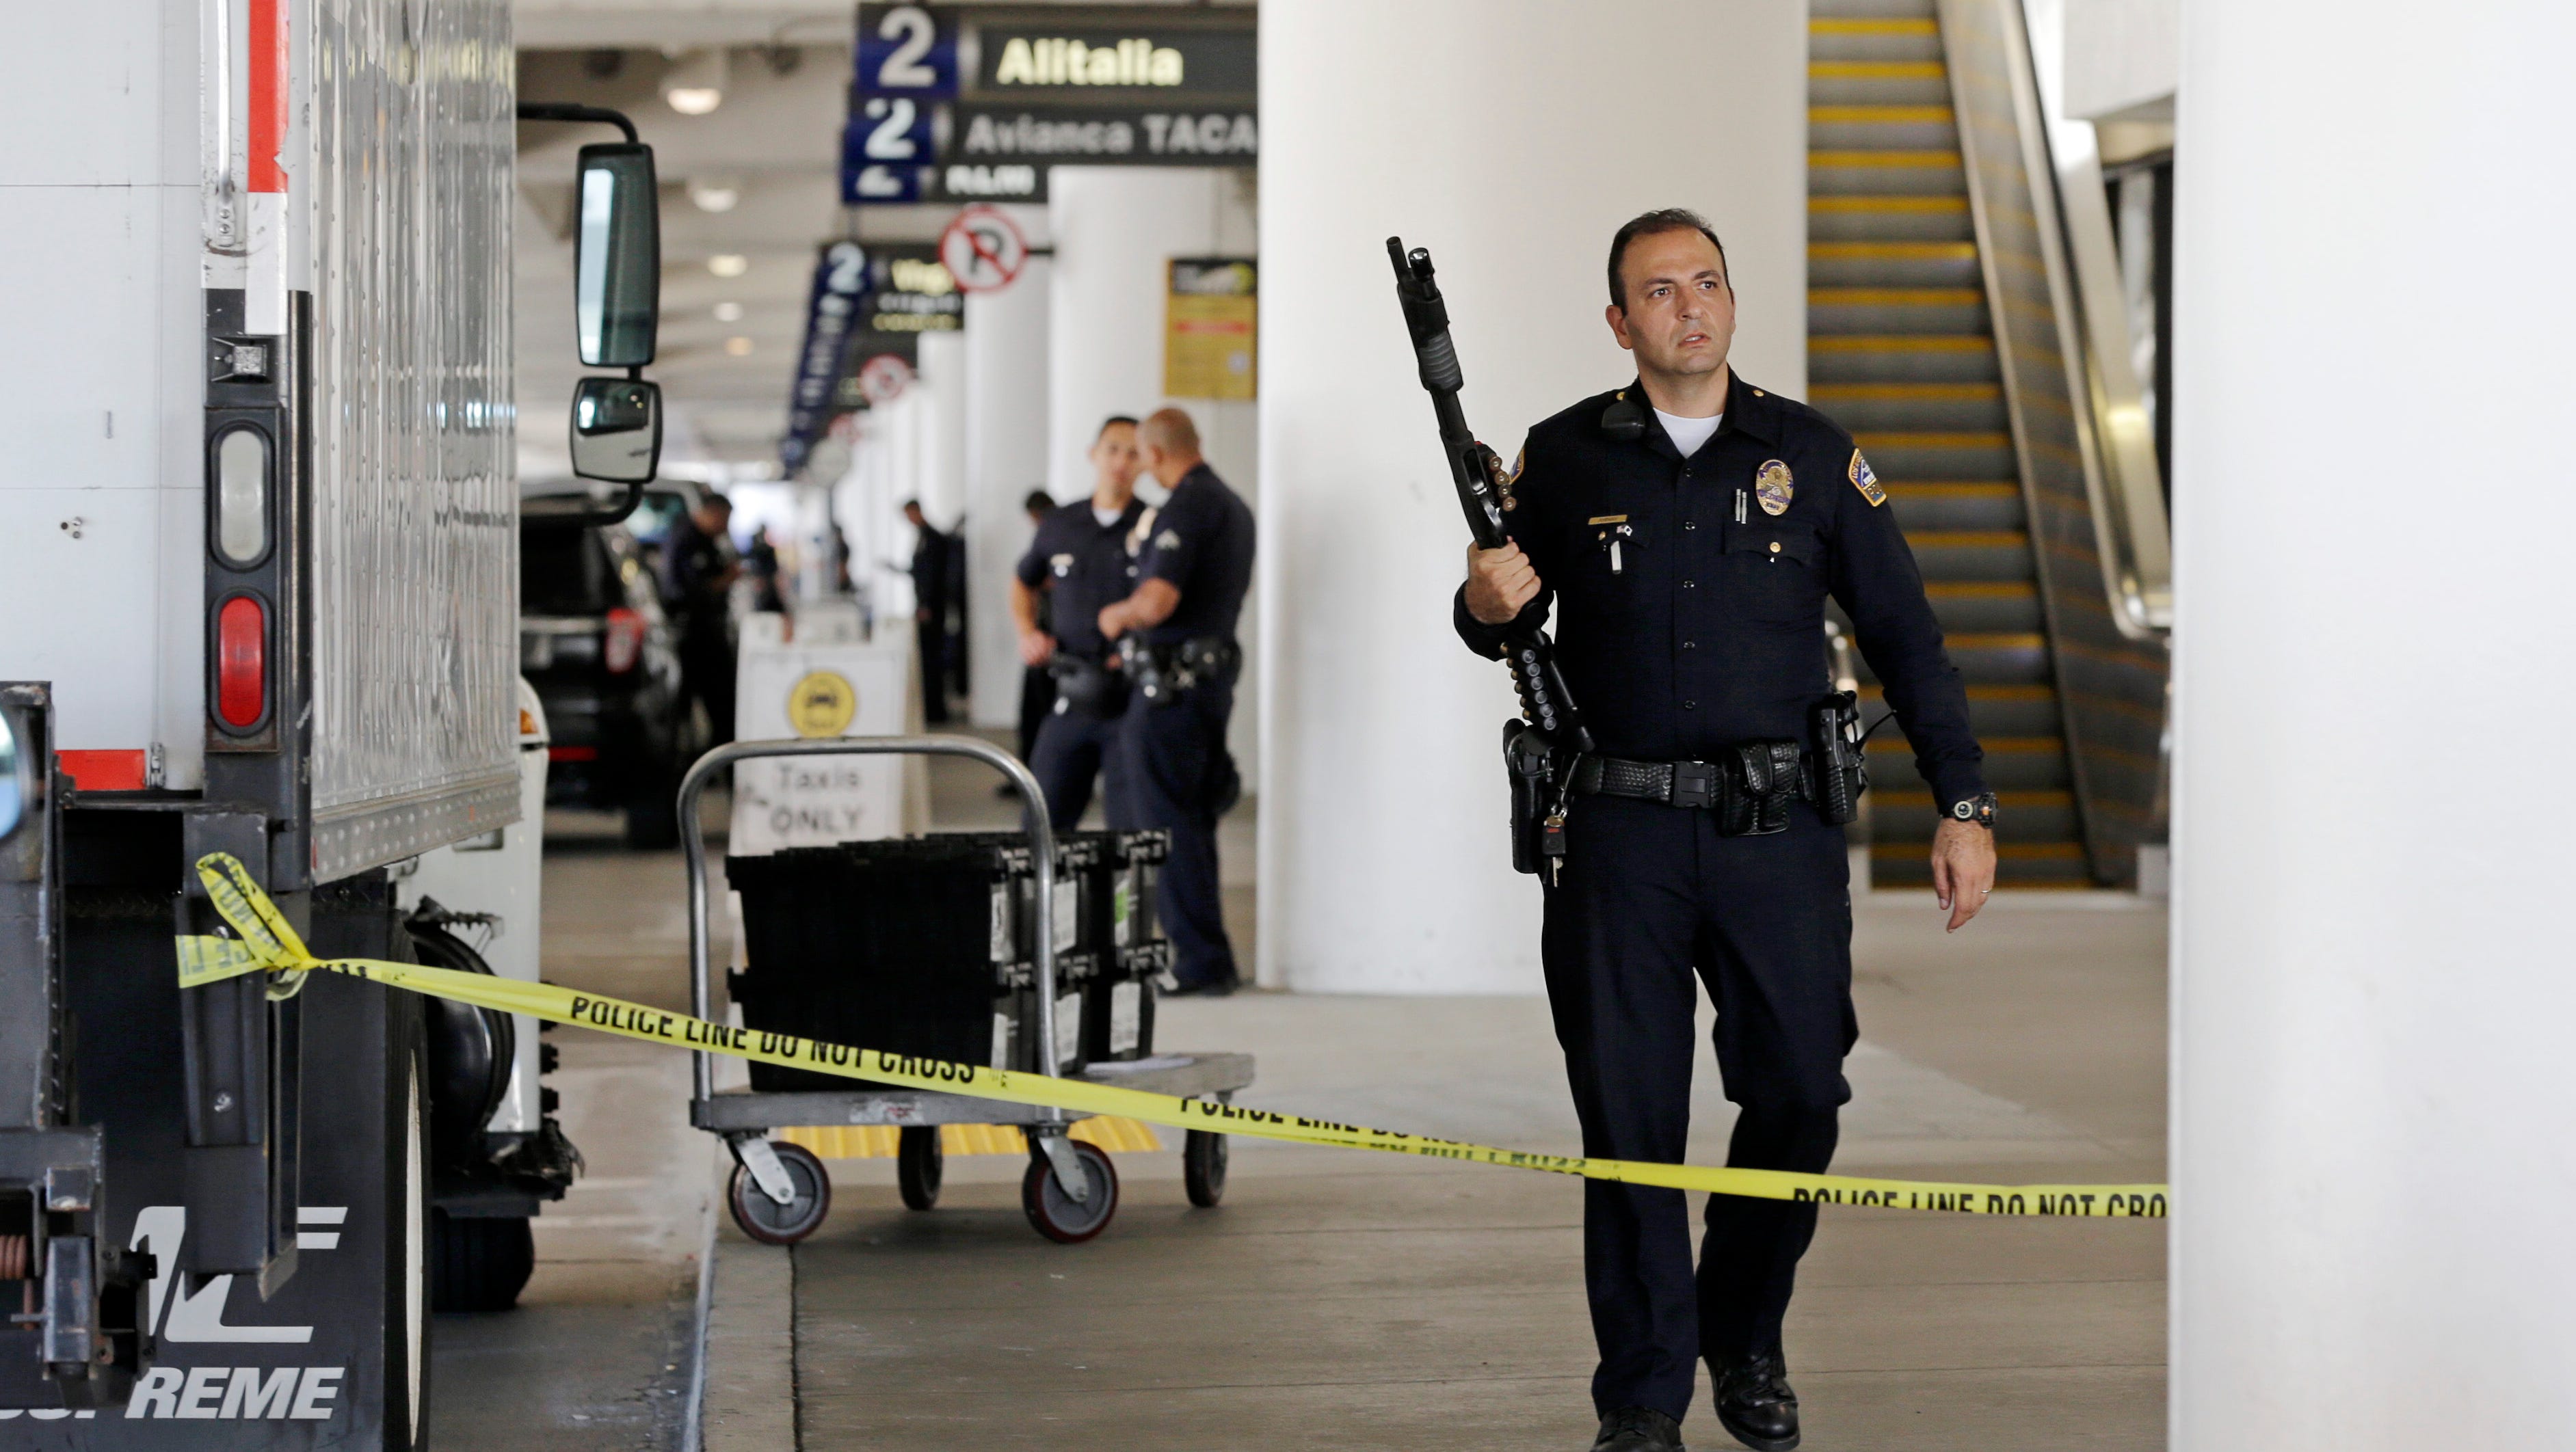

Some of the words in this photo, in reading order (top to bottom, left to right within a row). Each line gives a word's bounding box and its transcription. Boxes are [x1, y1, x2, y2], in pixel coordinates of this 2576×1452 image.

[877, 7, 936, 87] 2
[996, 38, 1184, 85] Alitalia
[864, 98, 916, 159] 2
[1142, 113, 1256, 154] TACA
[827, 242, 866, 294] 2
[778, 763, 859, 789] Taxis
[770, 805, 862, 835] ONLY
[571, 996, 673, 1037] POLICE
[686, 1020, 747, 1050] LINE
[2039, 1194, 2095, 1216] NOT
[2108, 1194, 2166, 1218] CRO
